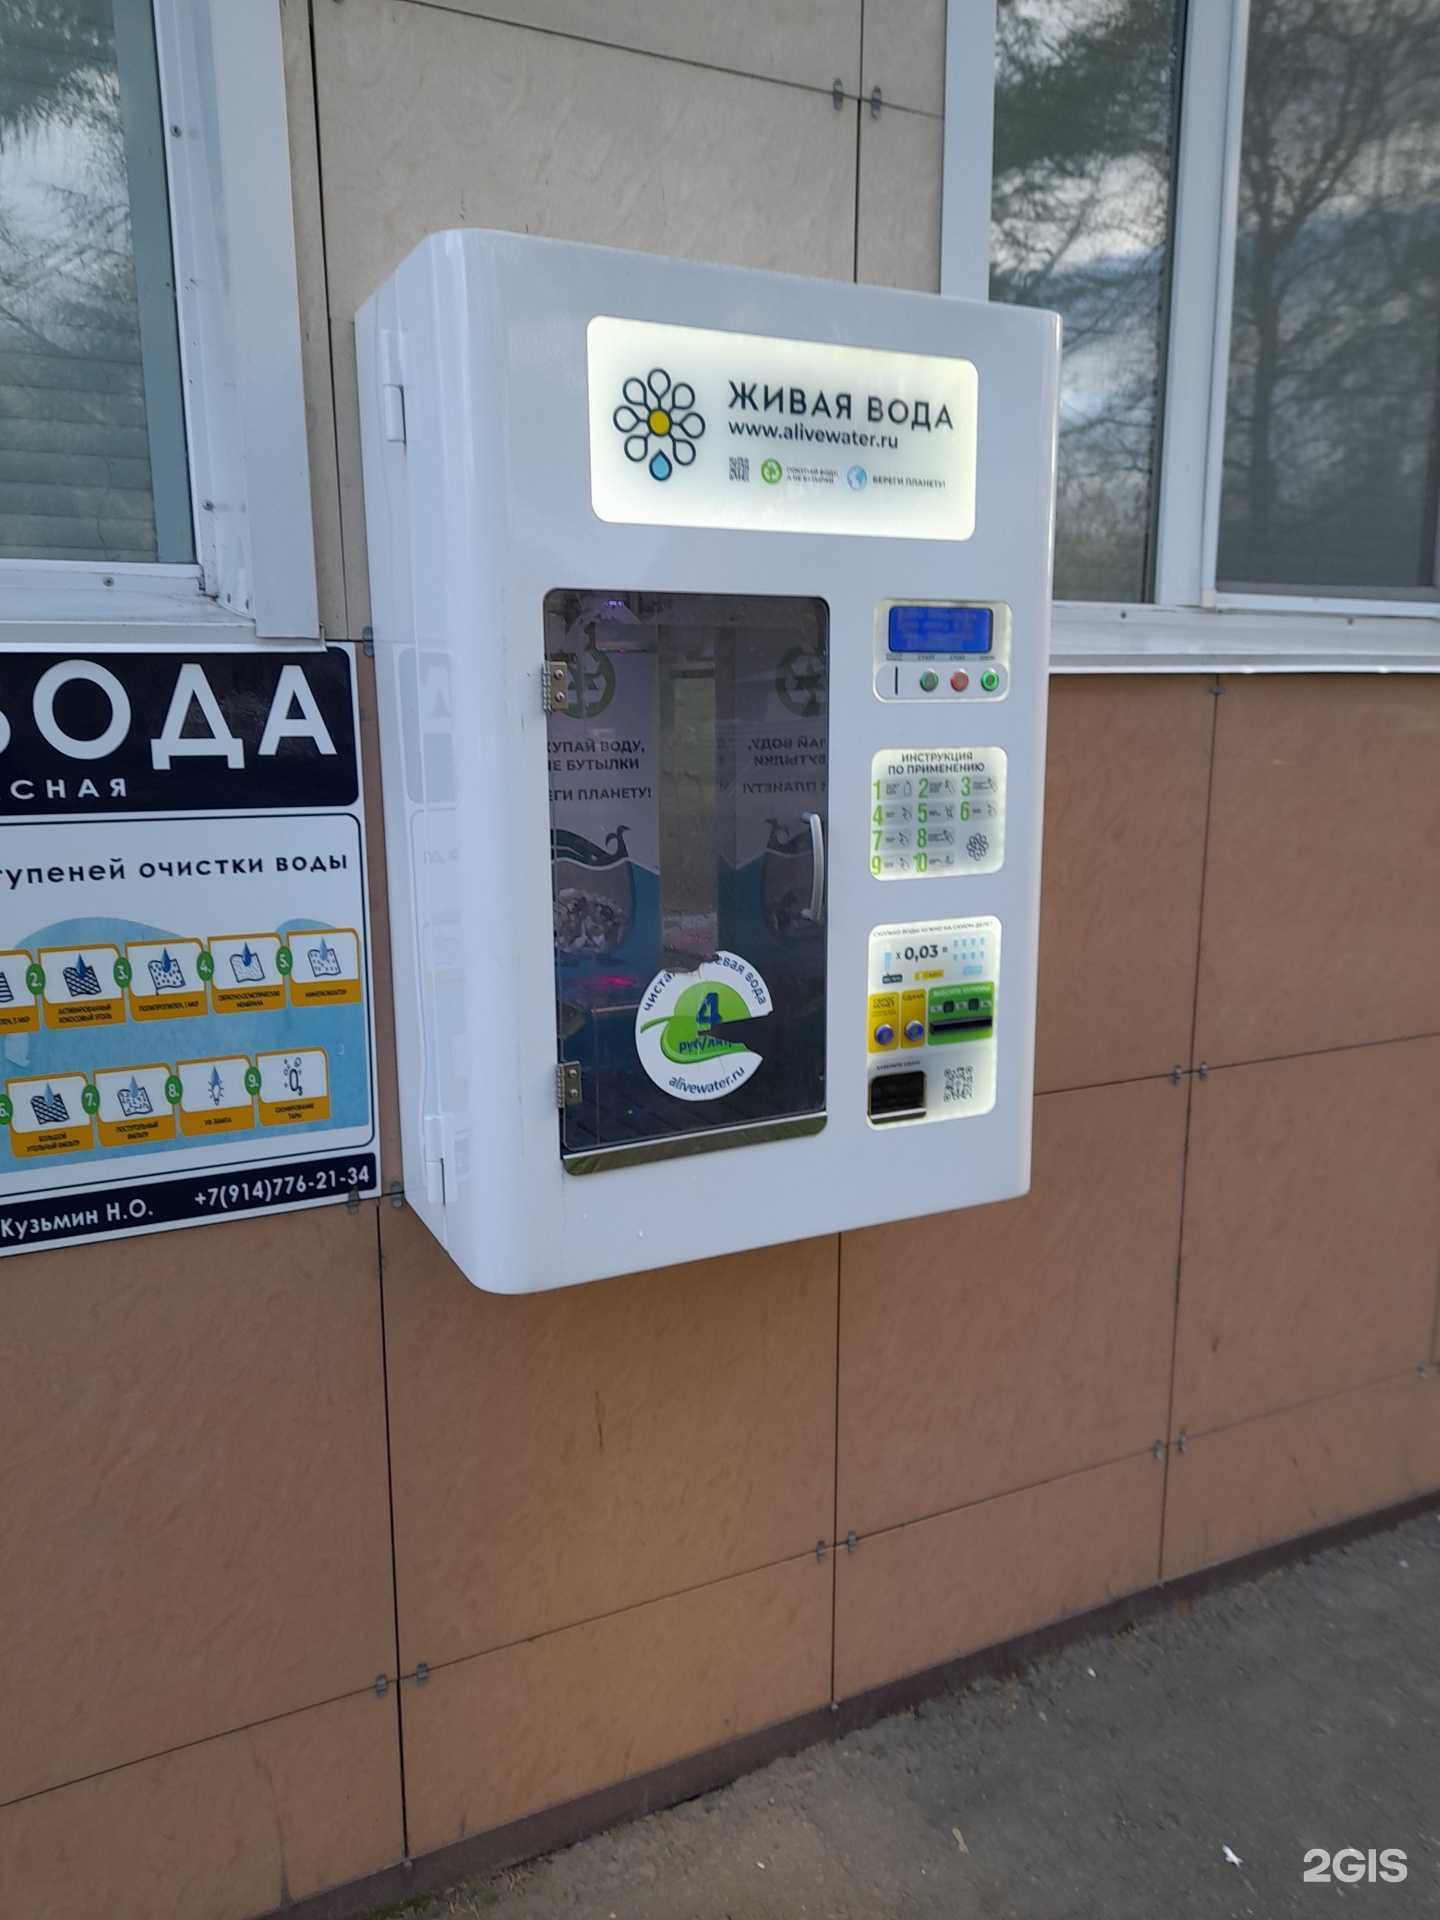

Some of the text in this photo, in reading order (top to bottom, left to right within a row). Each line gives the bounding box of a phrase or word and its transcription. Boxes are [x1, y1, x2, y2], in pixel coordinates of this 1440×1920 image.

[728, 380, 954, 432] ЖИВАЯ ВОДА
[728, 420, 900, 450] www.alivewater.ru
[873, 474, 904, 486] БЕРЕГИ
[600, 739, 645, 754] ВОДУ,
[567, 758, 640, 771] БУТЫЛКИ
[901, 751, 974, 764] ИНСТРУКЦИЯ
[889, 763, 985, 775] ПО ПРИМЕНЕНИЮ
[0, 778, 127, 801] СНАЯ
[578, 787, 652, 801] ПЛАНЕТУ!
[873, 780, 881, 800] 1
[918, 778, 929, 799] 2
[960, 776, 971, 796] 3
[872, 805, 882, 826] 4
[918, 803, 928, 823] 5
[960, 801, 970, 821] 6
[872, 830, 883, 851] 7
[917, 828, 927, 849] 8
[139, 858, 263, 878] очистки
[276, 854, 348, 872] воды
[871, 856, 881, 875] 9
[279, 954, 290, 968] 5.
[904, 944, 938, 962] 0,03
[199, 958, 211, 973] 4.
[31, 972, 42, 987] 2.
[745, 972, 766, 1005] вода
[696, 992, 722, 1024] 4
[168, 1083, 180, 1098] 8.
[248, 1074, 259, 1088] 9.
[668, 1066, 745, 1095] alivewater.ru
[86, 1092, 97, 1107] 7.
[1, 1165, 370, 1239] Кузьмин Н.О. +7(914)776-21-34
